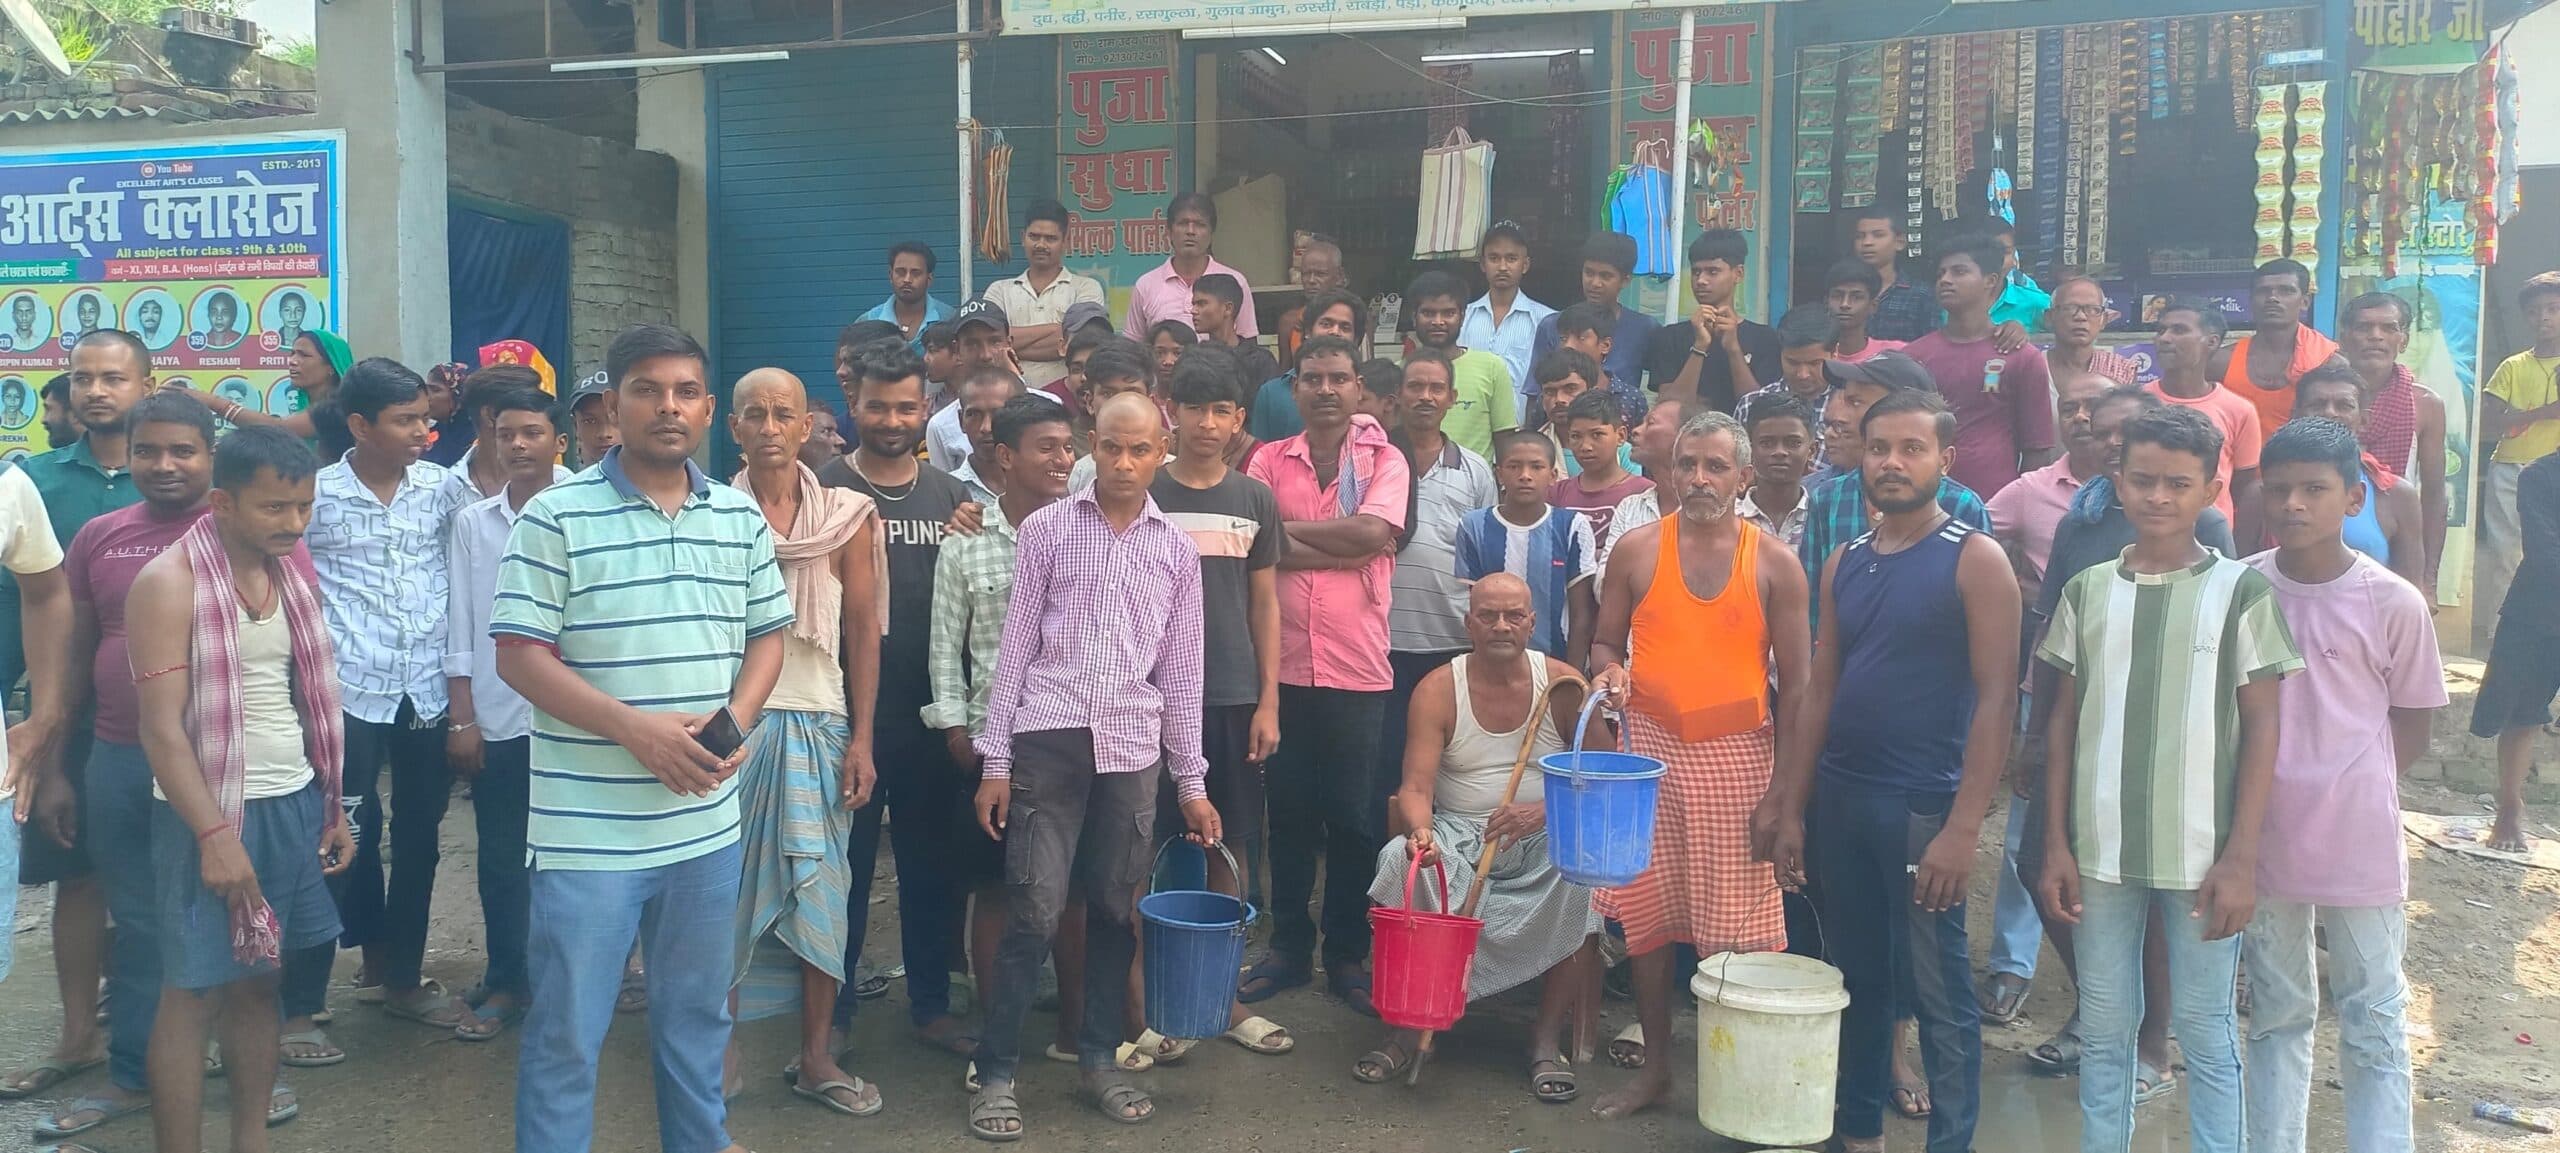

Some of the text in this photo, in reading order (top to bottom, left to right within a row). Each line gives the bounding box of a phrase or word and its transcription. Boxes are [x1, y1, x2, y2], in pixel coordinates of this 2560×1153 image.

[296, 158, 321, 169] 2013
[116, 179, 160, 189] EXCELLENT
[187, 176, 224, 185] CLASSES
[1065, 149, 1172, 212] सुधा
[0, 170, 319, 257] आर्ट्स क्लासेज
[116, 248, 132, 259] All
[134, 247, 178, 260] subject
[180, 246, 198, 257] for
[201, 245, 233, 257] class
[242, 244, 263, 255] 9th
[265, 243, 276, 254] &
[279, 242, 307, 254] 10th
[162, 263, 181, 274] B.A.
[183, 262, 213, 275] (Hons)
[960, 301, 986, 318] BOY
[580, 370, 609, 389] BO
